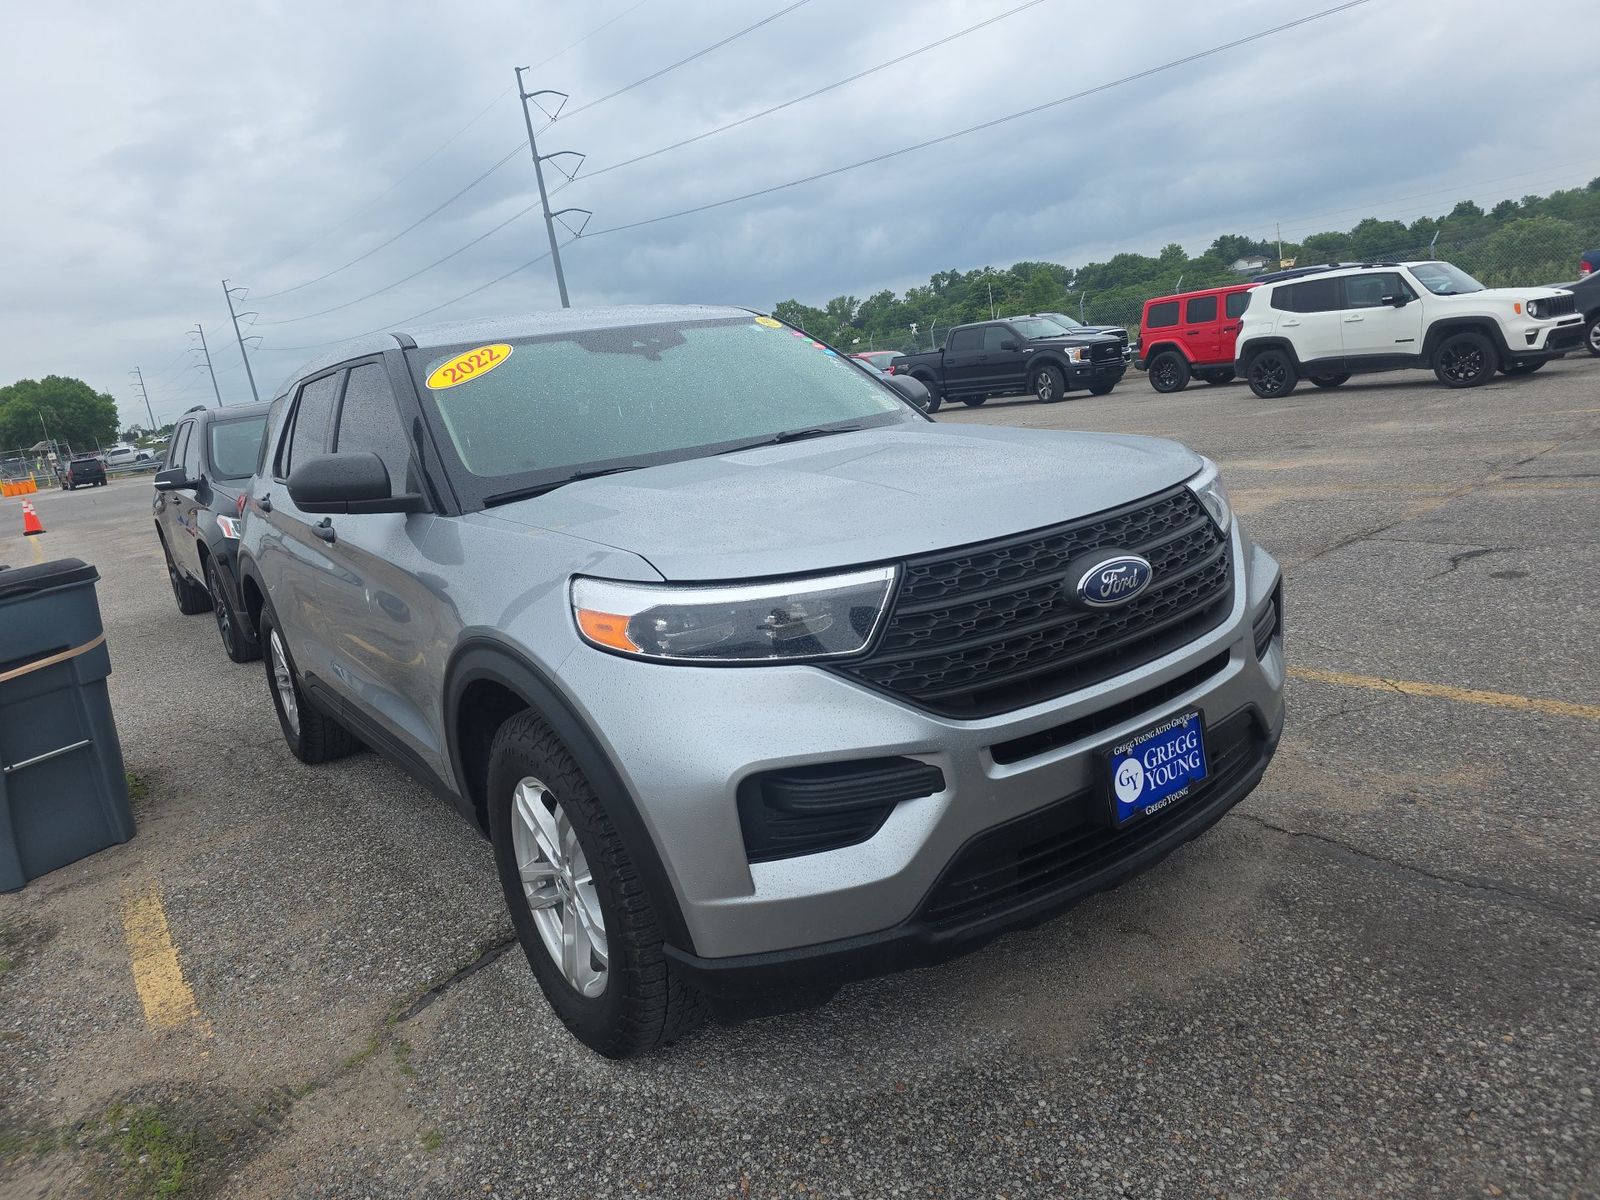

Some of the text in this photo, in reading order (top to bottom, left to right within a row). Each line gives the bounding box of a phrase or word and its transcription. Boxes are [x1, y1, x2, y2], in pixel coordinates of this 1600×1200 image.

[442, 348, 501, 383] 2022
[1100, 566, 1139, 597] Ford
[1114, 741, 1135, 755] GREGG
[1134, 731, 1155, 746] YOUNG
[1155, 723, 1171, 735] AUTO
[1144, 730, 1197, 769] GREGG
[1119, 769, 1139, 791] GY
[1145, 750, 1201, 791] YOUNG
[1145, 787, 1189, 815] GREGG YOUNG
